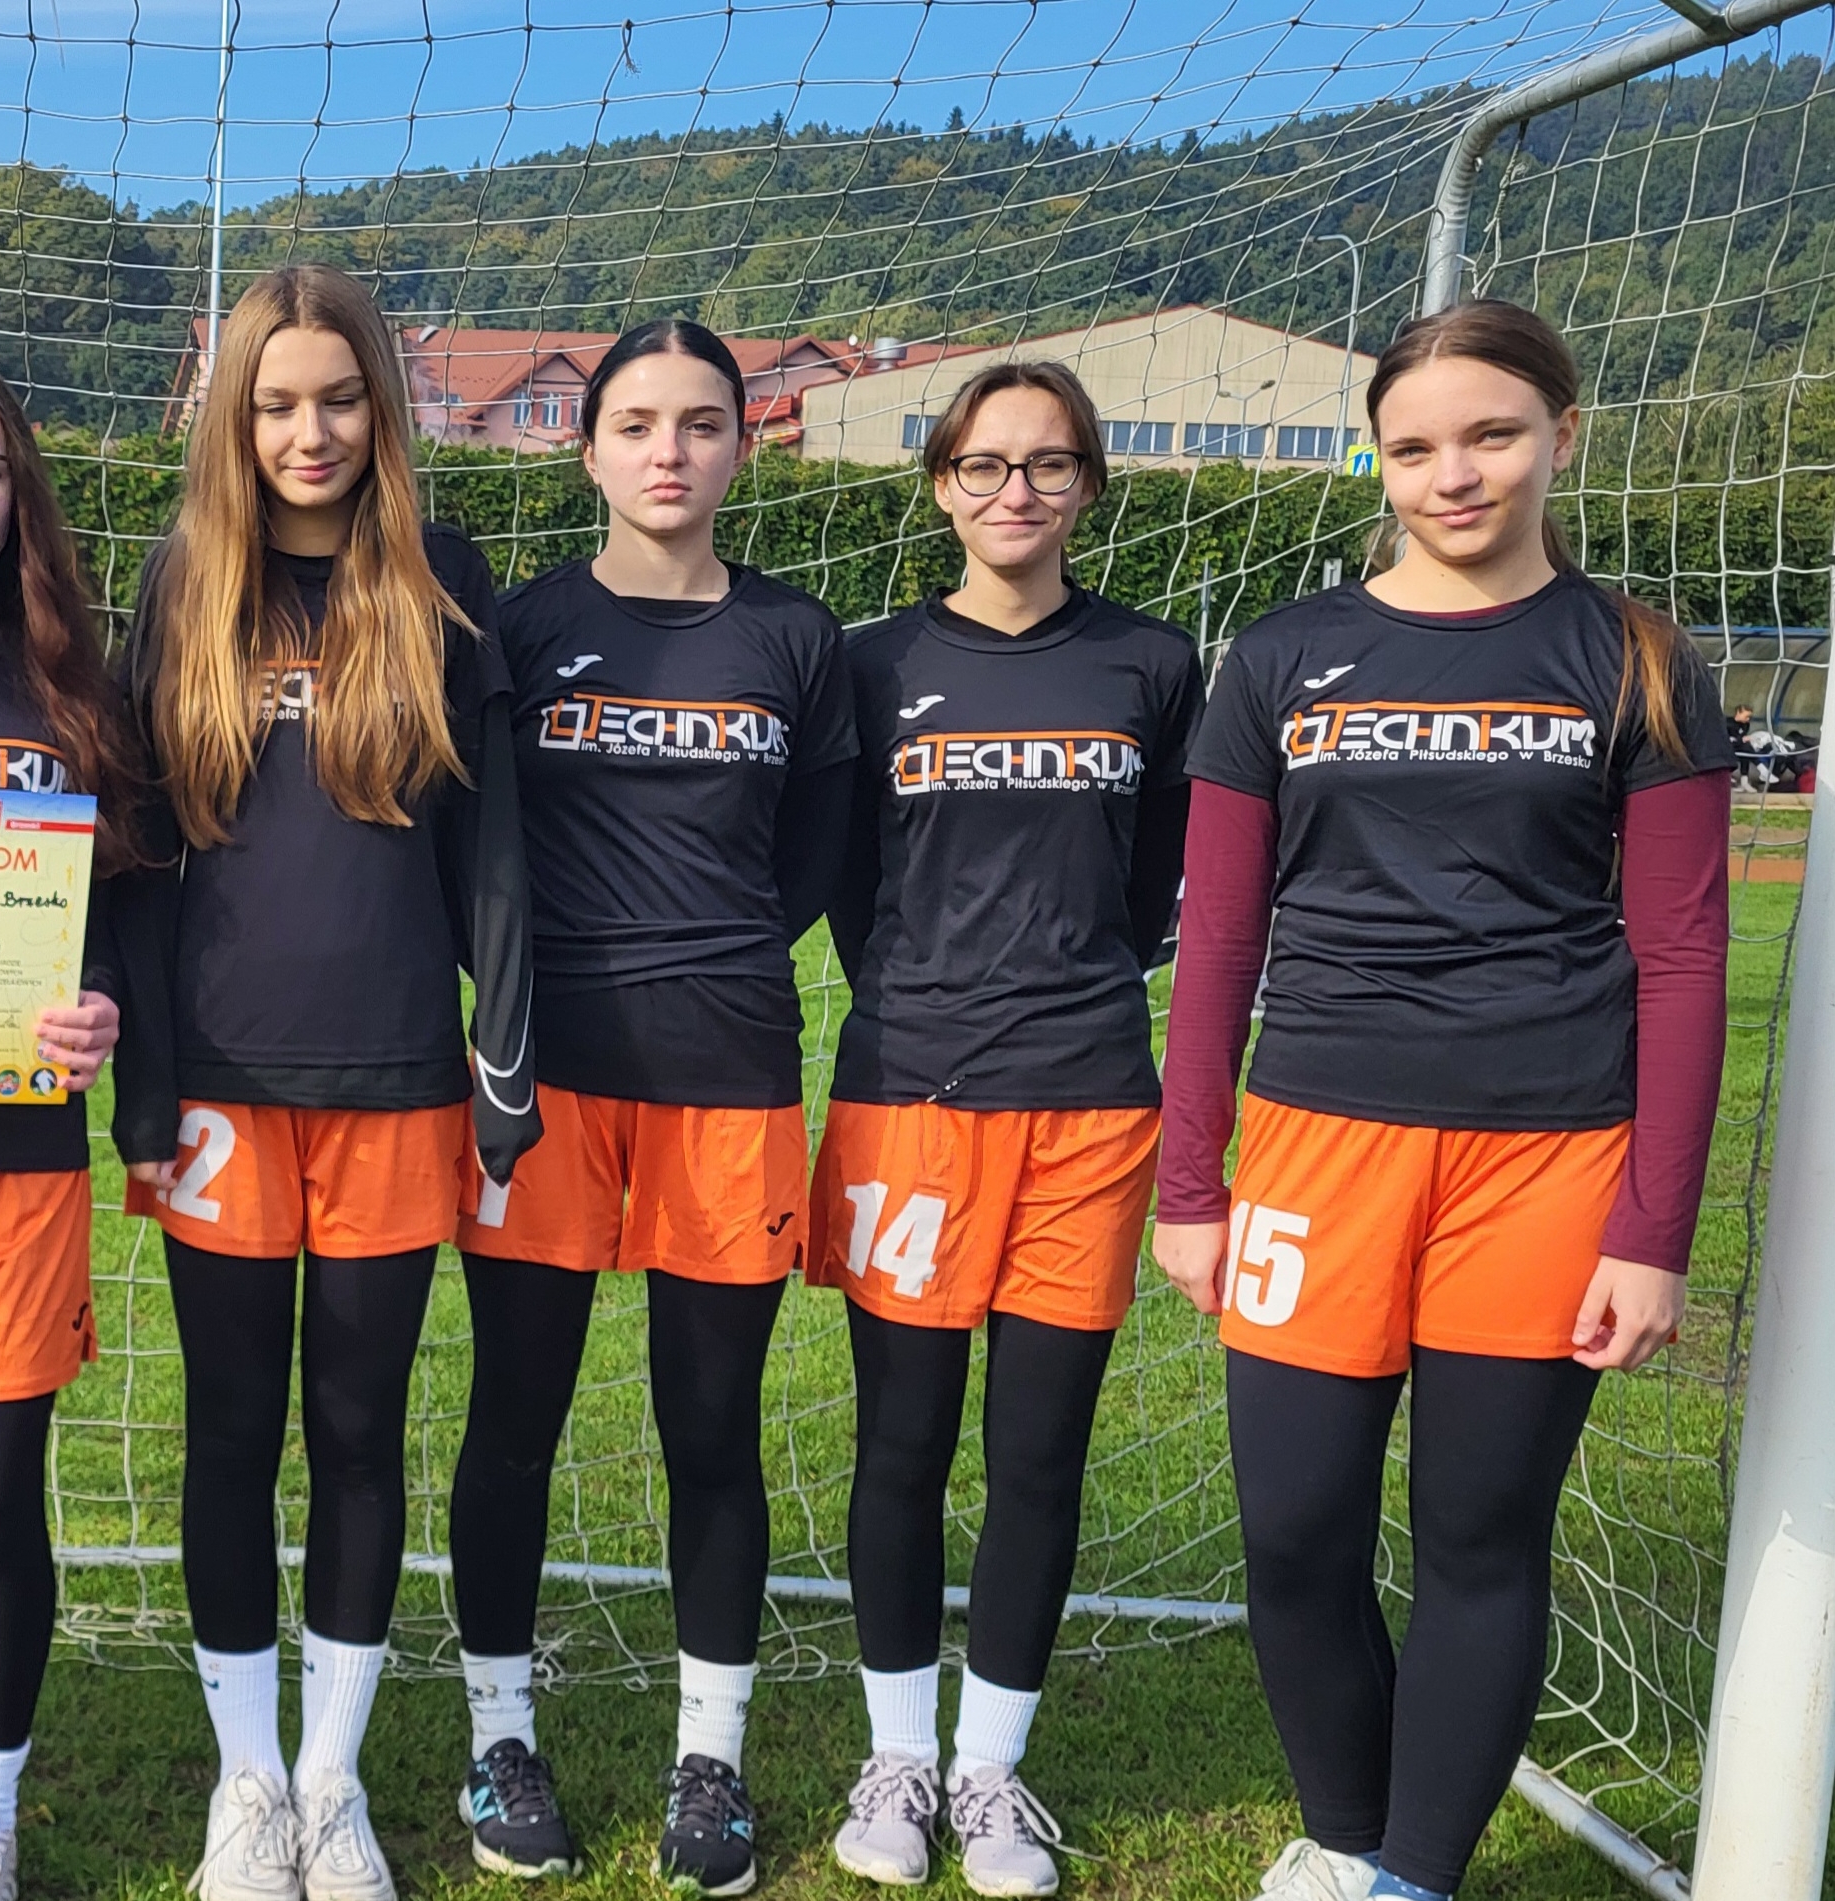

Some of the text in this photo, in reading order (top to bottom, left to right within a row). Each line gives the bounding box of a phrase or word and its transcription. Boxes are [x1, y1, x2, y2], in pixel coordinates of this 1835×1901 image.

[606, 741, 651, 757] Józefa
[1320, 748, 1592, 769] im. Józefa Piłsudskiego w Brzesku
[954, 777, 999, 791] Józefa
[156, 1108, 236, 1224] 2
[844, 1179, 947, 1299] 14
[1222, 1198, 1311, 1327] 15
